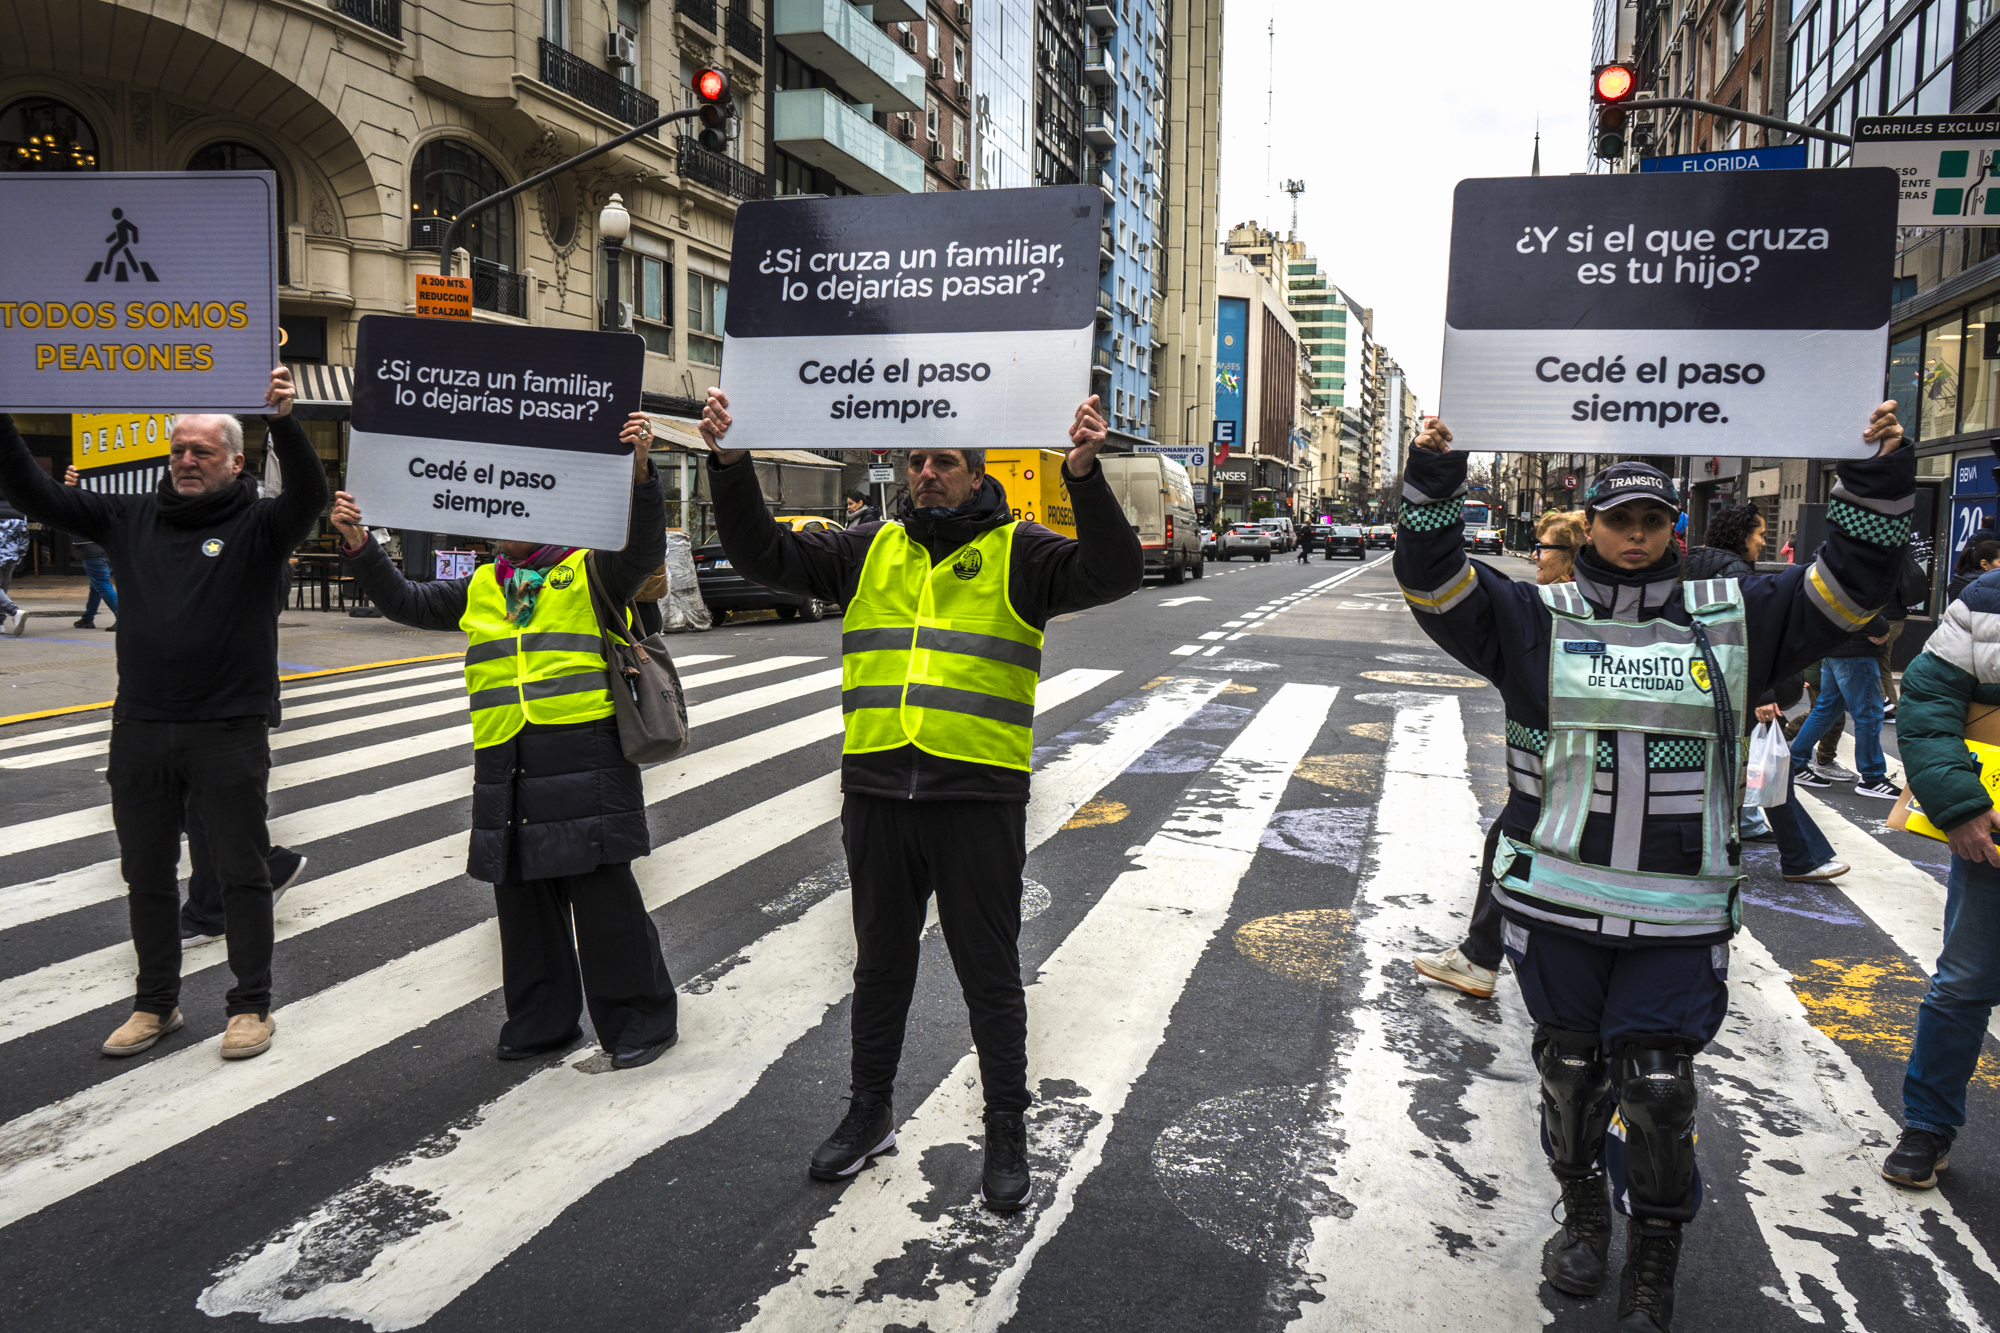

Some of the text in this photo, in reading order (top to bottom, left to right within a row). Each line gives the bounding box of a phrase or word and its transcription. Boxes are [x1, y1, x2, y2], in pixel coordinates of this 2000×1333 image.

[1862, 123, 1933, 135] CARRILES
[1683, 155, 1760, 172] FLORIDA
[1516, 224, 1830, 257] ¿Y si el que cruza
[758, 239, 1065, 274] ¿Si cruza un familiar,
[421, 277, 466, 288] A 200 MTS.
[782, 268, 1046, 304] lo dejarías pasar?
[1577, 254, 1760, 289] es tu hijo?
[418, 306, 469, 317] DE CALZADA
[419, 291, 468, 303] REDUCCION
[0, 301, 249, 330] TODOS SOMOS
[35, 343, 215, 372] PEATONES
[1535, 354, 1766, 389] Cedé el paso
[377, 359, 614, 402] ¿Si cruza un familiar,
[799, 358, 991, 388] Cedé el paso
[395, 383, 599, 422] lo dejarías pasar?
[830, 394, 958, 424] siempre.
[1570, 393, 1729, 429] siempre.
[1217, 422, 1232, 441] E
[408, 457, 556, 490] Cedé el paso
[1193, 455, 1202, 465] E
[1959, 465, 1977, 483] BBVA
[1216, 471, 1247, 481] ANSES
[433, 490, 530, 518] siempre.
[1589, 654, 1684, 677] TRÁNSITO
[1588, 675, 1684, 691] DE LA CIUDAD
